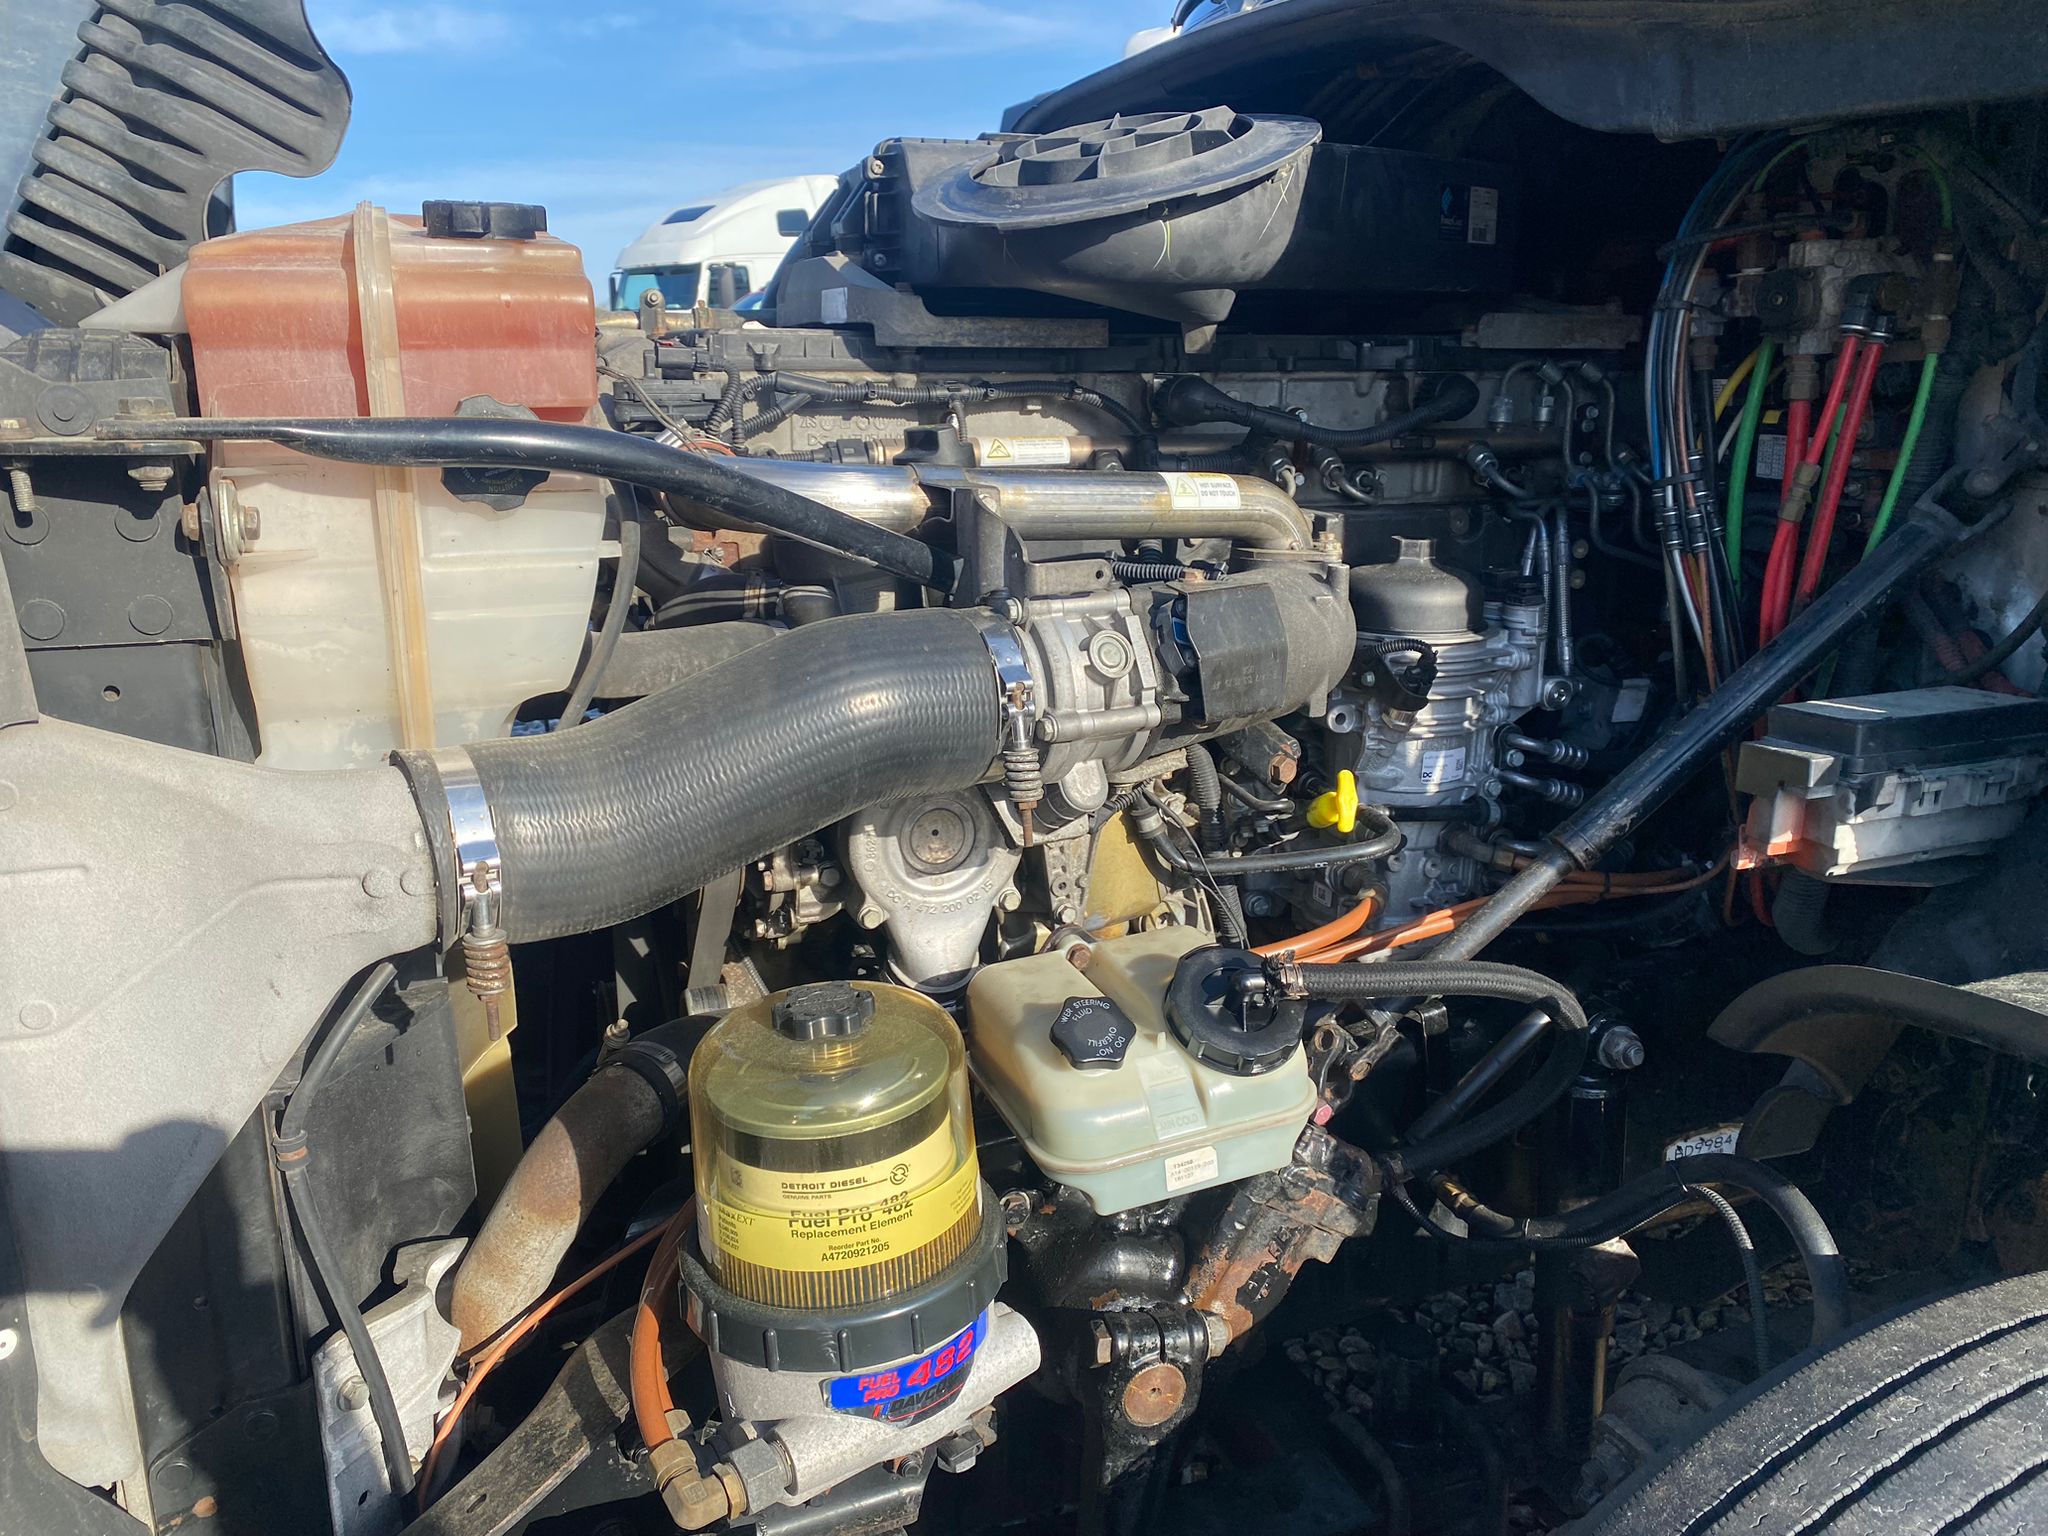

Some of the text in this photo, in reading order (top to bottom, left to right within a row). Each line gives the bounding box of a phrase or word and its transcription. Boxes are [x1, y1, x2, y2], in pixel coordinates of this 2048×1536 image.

[942, 901, 962, 913] 200
[967, 892, 982, 905] 02
[980, 880, 994, 893] 15
[1071, 1007, 1093, 1021] FLUID
[1072, 999, 1111, 1010] STEERING
[1087, 1026, 1117, 1047] OVERFILL
[1114, 1035, 1126, 1048] DO
[781, 1176, 869, 1191] DETROIT DIESEL
[788, 1209, 831, 1228] Fuel
[837, 1206, 873, 1226] Pro
[791, 1208, 913, 1240] Replacement Element
[821, 1241, 890, 1262] A4720921205
[828, 1237, 881, 1251] Reorder Part No.
[858, 1329, 975, 1391] FUEL 482
[863, 1384, 900, 1403] PRO
